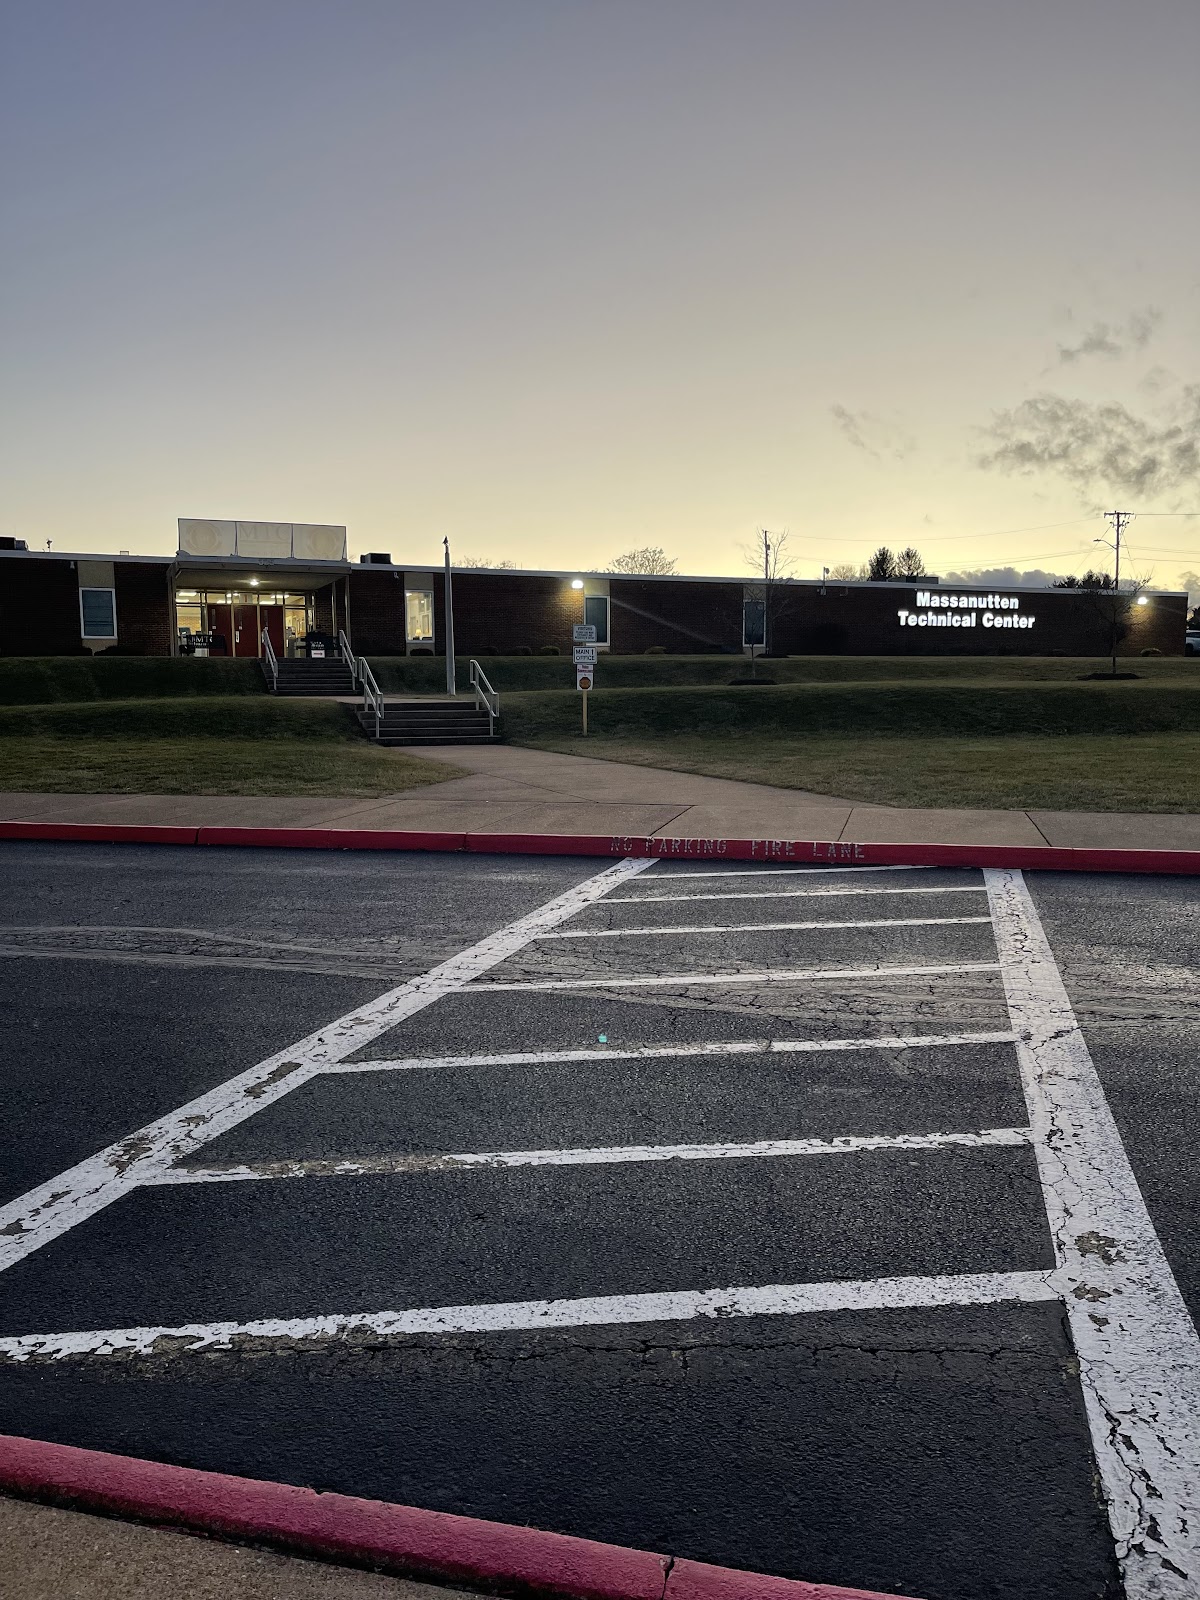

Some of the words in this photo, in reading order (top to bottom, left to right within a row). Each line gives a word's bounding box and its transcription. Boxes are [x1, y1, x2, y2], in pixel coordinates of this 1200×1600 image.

[916, 591, 1019, 609] Massanutten
[897, 610, 976, 627] Technical
[982, 612, 1036, 629] Center
[610, 836, 633, 852] NO
[645, 837, 727, 854] PARKING
[751, 840, 796, 856] FIRE
[813, 841, 865, 859] LANE
